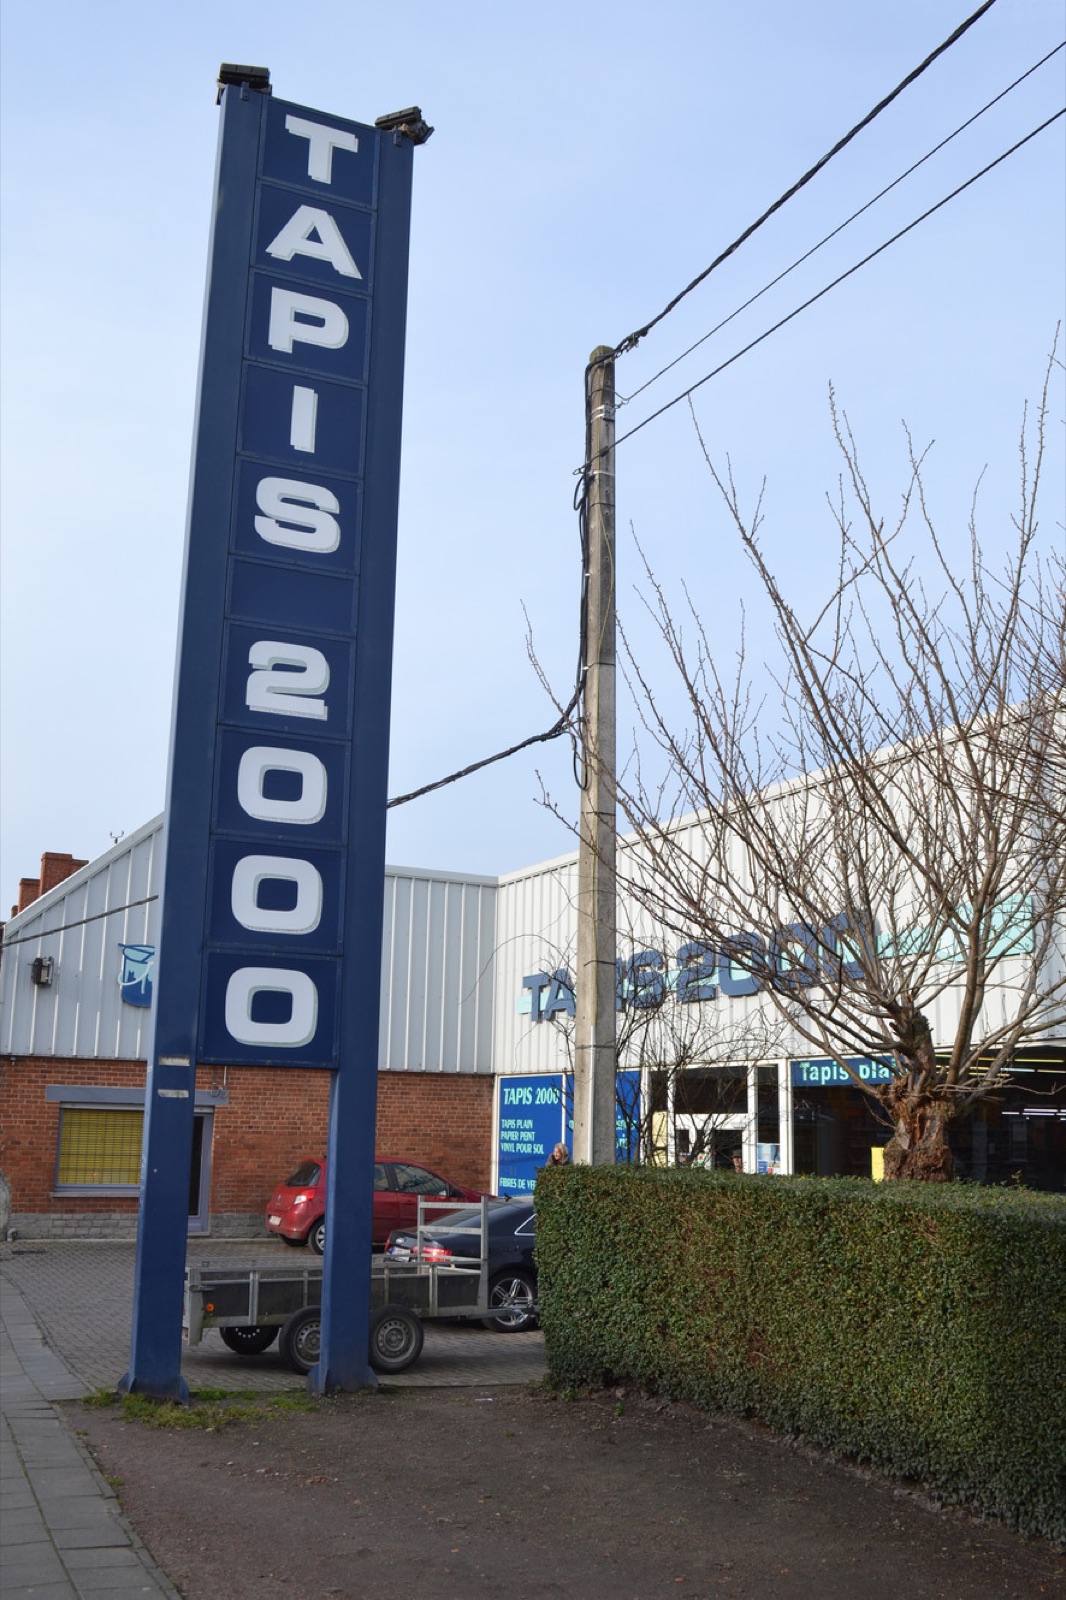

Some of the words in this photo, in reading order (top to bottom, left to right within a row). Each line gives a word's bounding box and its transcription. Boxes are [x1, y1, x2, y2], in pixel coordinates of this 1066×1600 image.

[254, 114, 362, 554] TAPIS
[225, 640, 331, 1048] 2000
[800, 1061, 849, 1085] Tapis
[503, 1087, 533, 1105] TAPIS
[535, 1087, 560, 1105] 2000
[501, 1118, 516, 1129] TAPIS
[516, 1119, 533, 1129] PLAIN
[500, 1131, 519, 1141] PAPIER
[520, 1131, 536, 1142] PEINT
[500, 1142, 515, 1153] VINYL
[515, 1143, 532, 1154] POUR
[533, 1143, 545, 1155] SOL
[518, 1179, 526, 1189] DE
